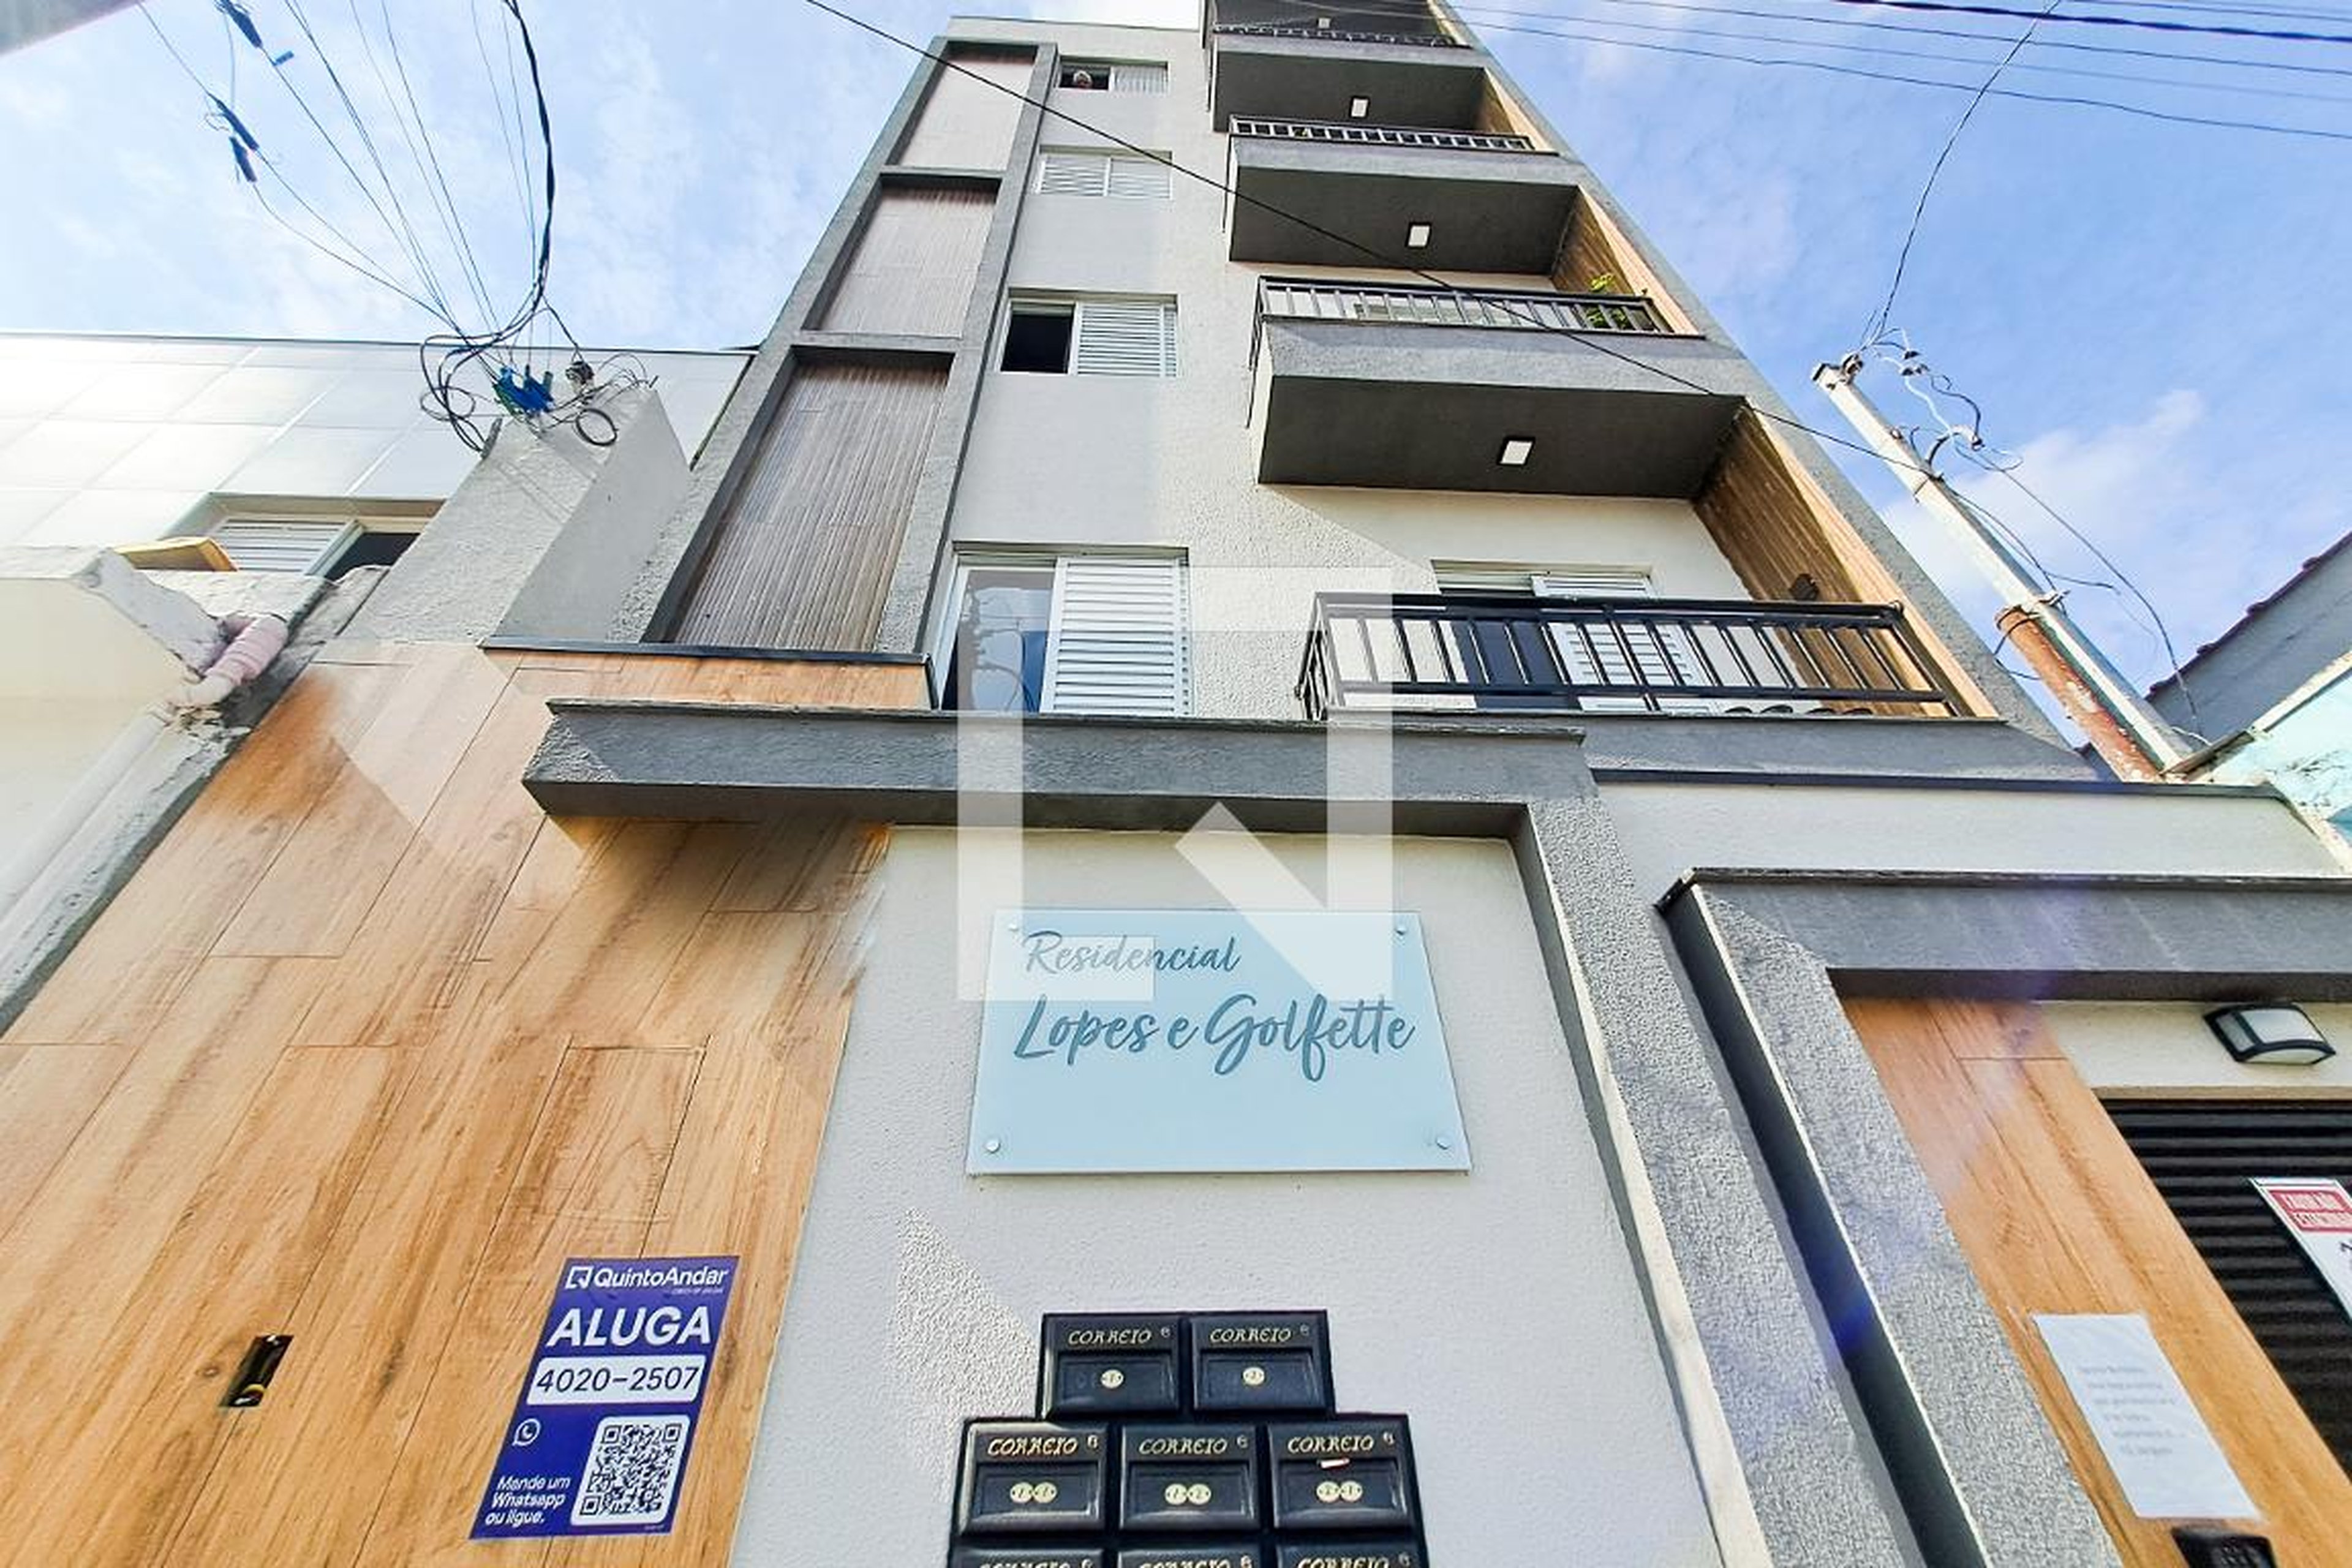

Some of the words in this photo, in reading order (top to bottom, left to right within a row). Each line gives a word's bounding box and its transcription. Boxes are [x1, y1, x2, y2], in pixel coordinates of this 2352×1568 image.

[1022, 930, 1242, 974] Residencial
[1014, 993, 1159, 1066] Lopes
[1167, 1013, 1199, 1052] e
[1205, 993, 1415, 1082] Golfette
[594, 1265, 728, 1288] QuintoAndar
[546, 1306, 711, 1348] ALUGA
[1210, 1327, 1291, 1343] CORREIO
[1068, 1329, 1152, 1345] CORREIO
[537, 1366, 699, 1392] 4020-2507
[987, 1437, 1079, 1457] CORREIO
[1139, 1438, 1228, 1455] CORREIO
[1287, 1435, 1374, 1453] CORREIO
[547, 1476, 571, 1490] um
[485, 1512, 506, 1526] ou
